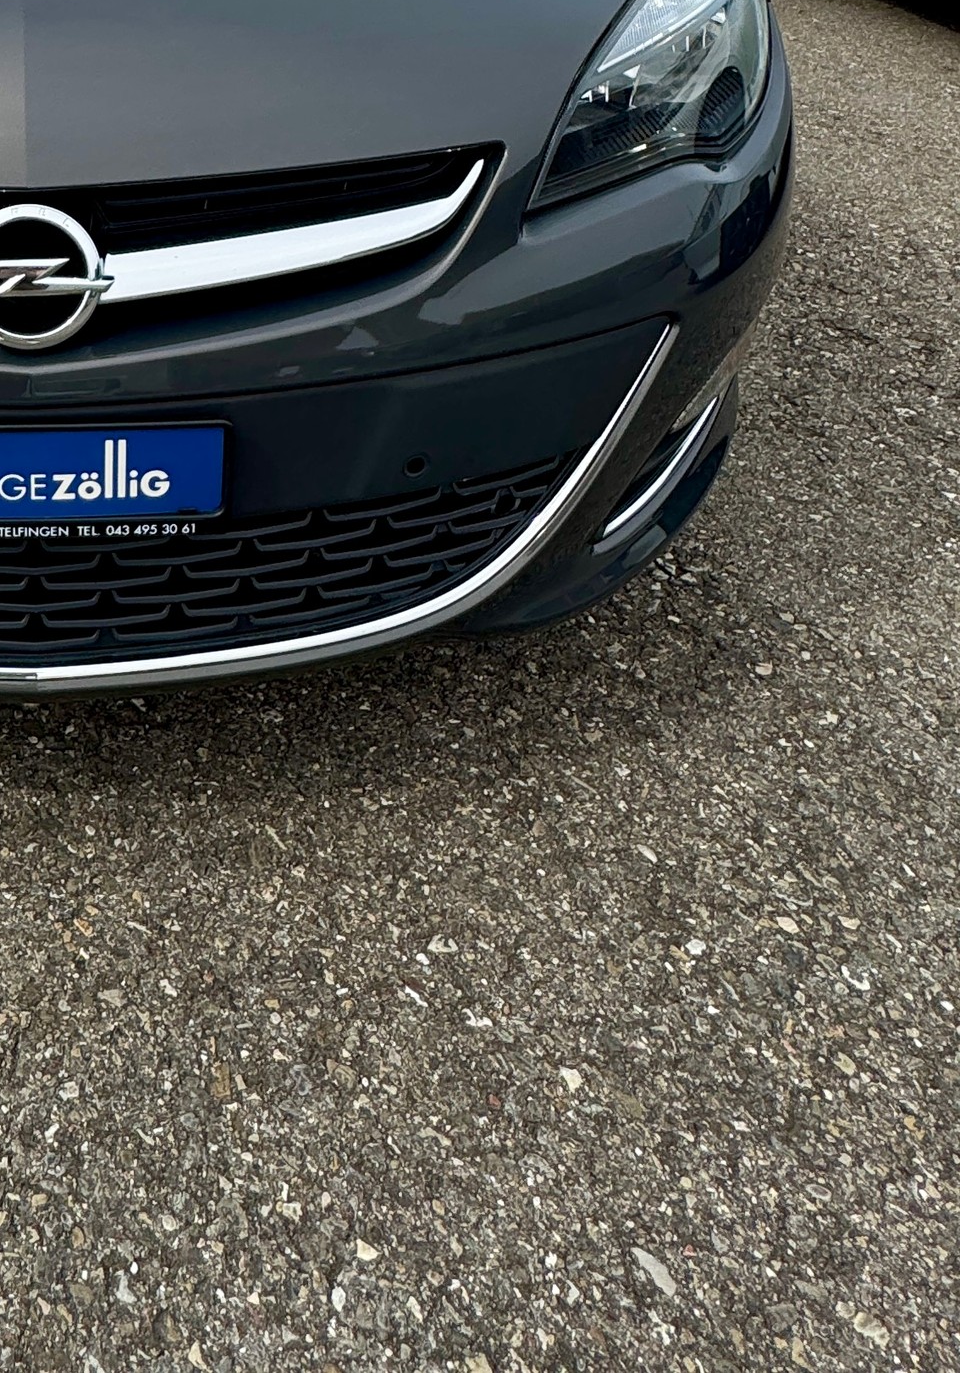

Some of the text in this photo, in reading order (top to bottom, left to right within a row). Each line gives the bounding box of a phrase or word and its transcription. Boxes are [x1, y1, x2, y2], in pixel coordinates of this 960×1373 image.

[106, 525, 130, 536] 043
[134, 524, 157, 536] 495
[161, 523, 178, 535] 30
[181, 523, 196, 534] 61
